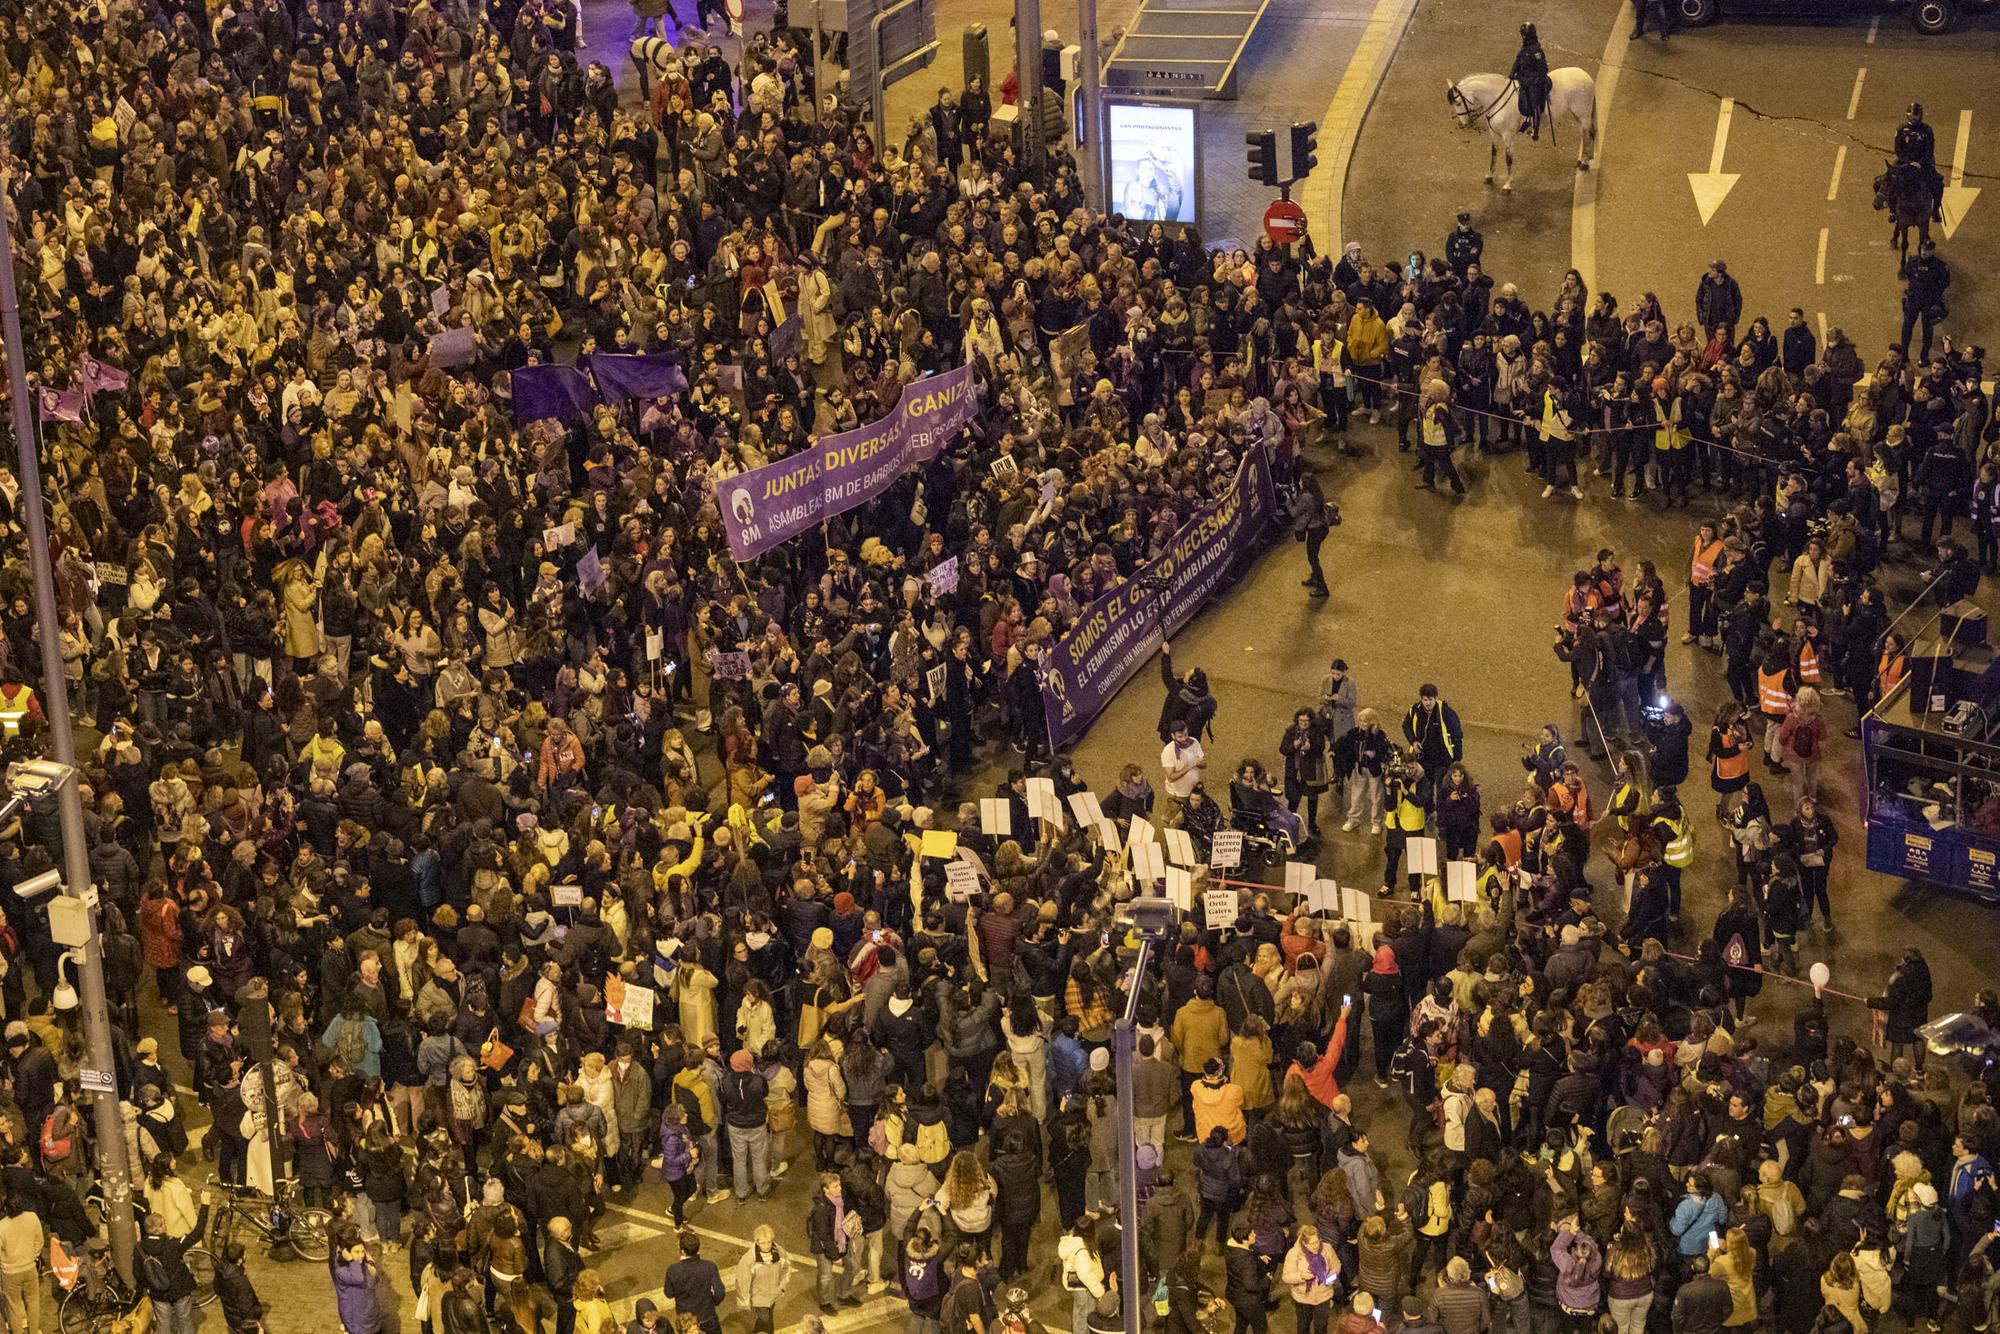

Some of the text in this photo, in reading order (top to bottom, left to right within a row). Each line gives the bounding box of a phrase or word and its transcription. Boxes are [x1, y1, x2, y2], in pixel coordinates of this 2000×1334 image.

[825, 487, 843, 504] 8M
[846, 480, 861, 497] DE
[863, 454, 900, 490] BARRIOS
[742, 524, 762, 546] 8M
[1077, 671, 1089, 689] EL
[1086, 624, 1130, 678] FEMINISMO
[1129, 611, 1145, 631] LO
[1172, 537, 1228, 594] CAMBIANDO
[1171, 584, 1207, 620] FEMINISTA
[1069, 611, 1108, 665] SOMOS
[1107, 596, 1126, 622] EL
[1214, 846, 1240, 854] Aguado
